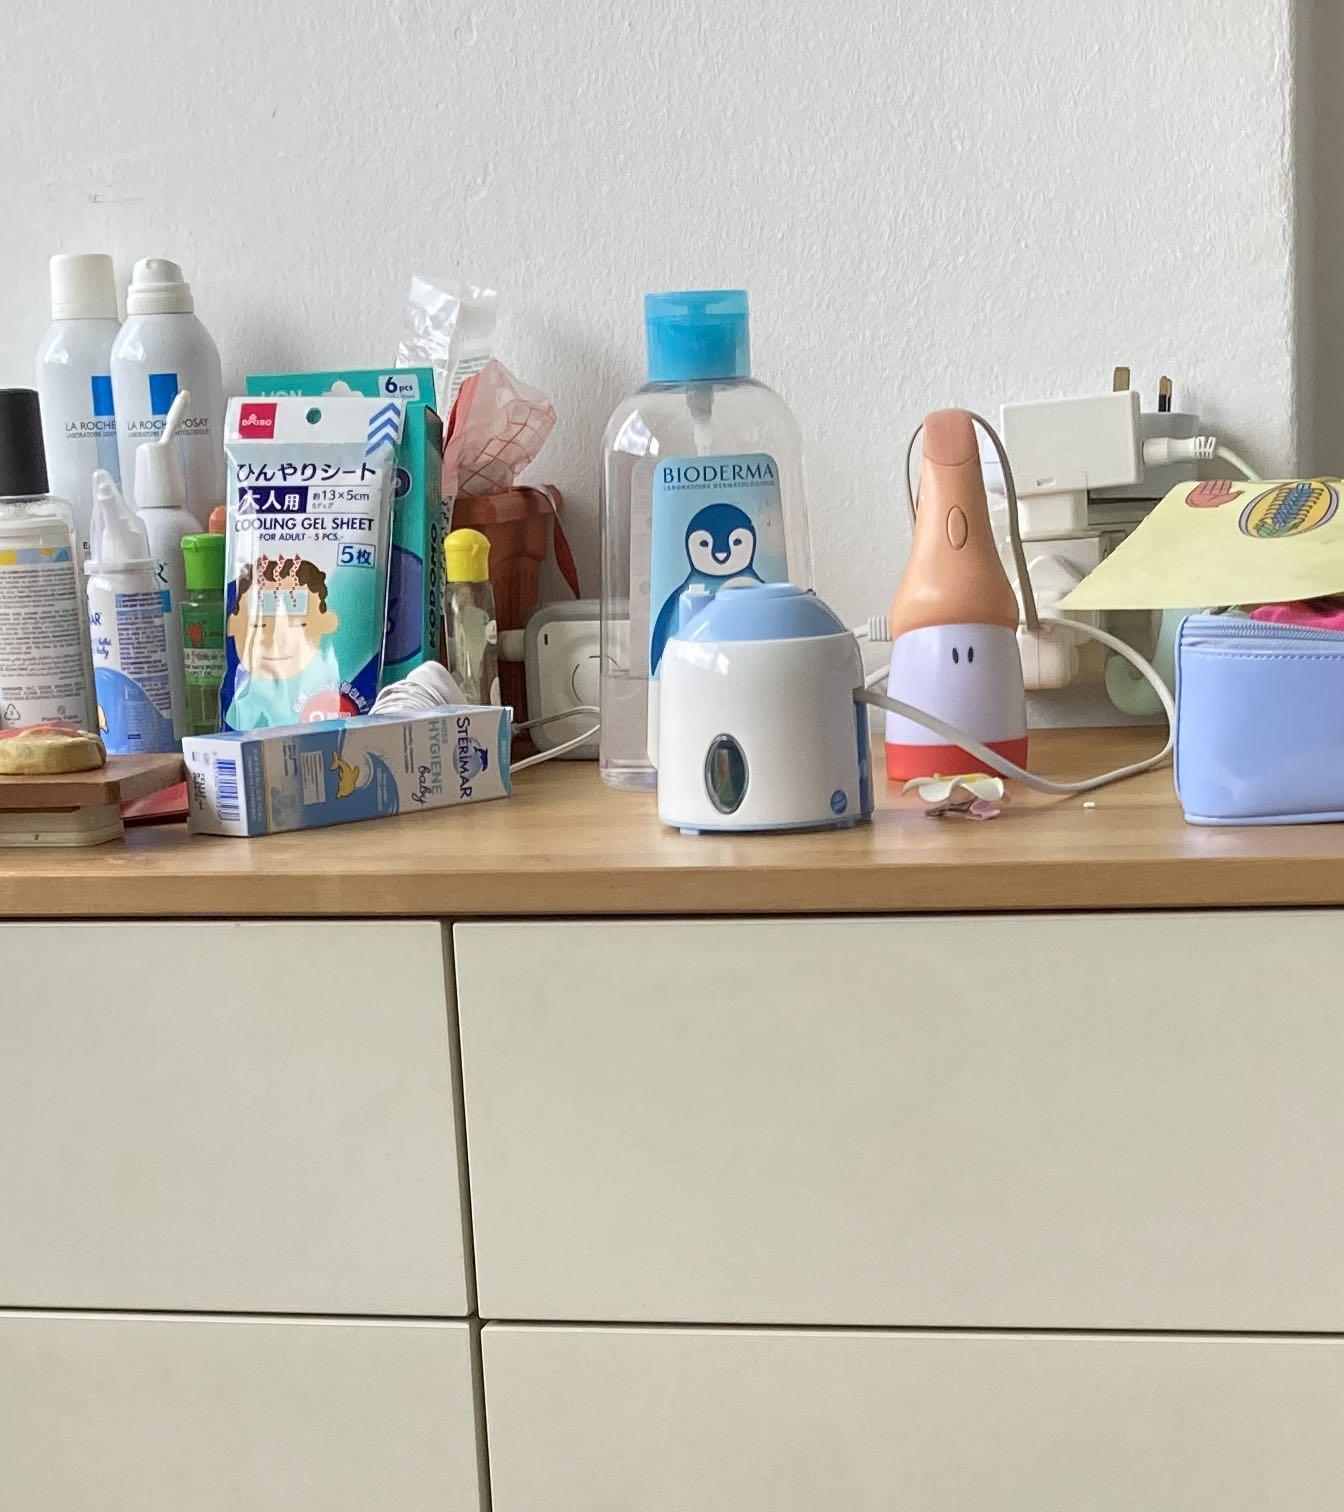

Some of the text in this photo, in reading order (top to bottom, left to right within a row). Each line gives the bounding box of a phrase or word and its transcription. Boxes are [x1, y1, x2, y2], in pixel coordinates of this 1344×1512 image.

[385, 376, 414, 394] 6 pcs
[236, 462, 377, 482] ひんやりシート
[663, 463, 774, 484] BIODERMA
[238, 490, 300, 513] 大人用
[234, 517, 375, 533] COOLING GEL SHEET
[259, 533, 276, 541] FOR
[278, 532, 307, 541] ADULT
[340, 546, 372, 566] 5枚
[428, 522, 438, 649] KODOMO
[428, 720, 443, 796] HYGIENE
[411, 765, 432, 805] baby
